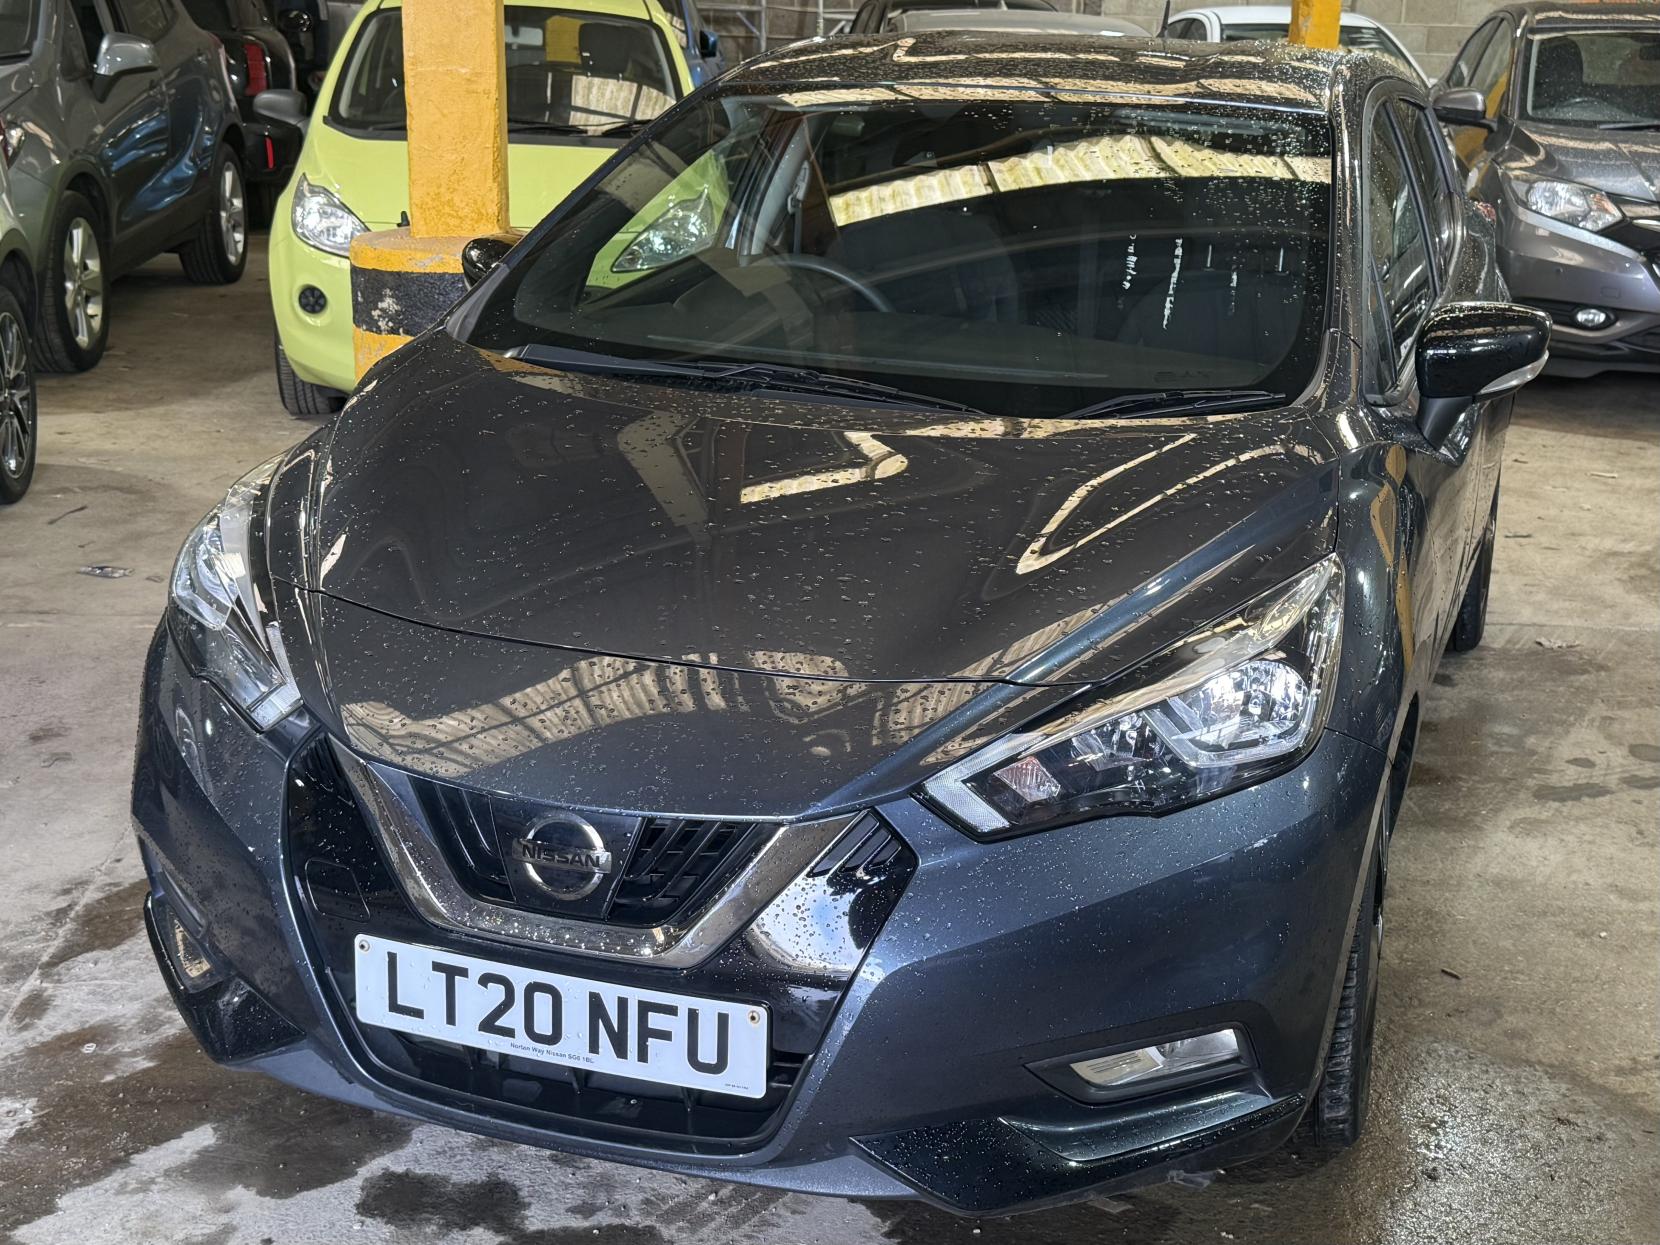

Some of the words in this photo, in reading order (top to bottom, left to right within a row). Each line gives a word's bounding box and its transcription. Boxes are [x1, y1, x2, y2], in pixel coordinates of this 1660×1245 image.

[521, 843, 600, 869] NISSAN
[387, 951, 563, 1046] LT20
[588, 991, 730, 1075] NFU
[510, 1042, 531, 1052] Norton
[532, 1046, 545, 1055] Way
[546, 1049, 567, 1058] Nissan
